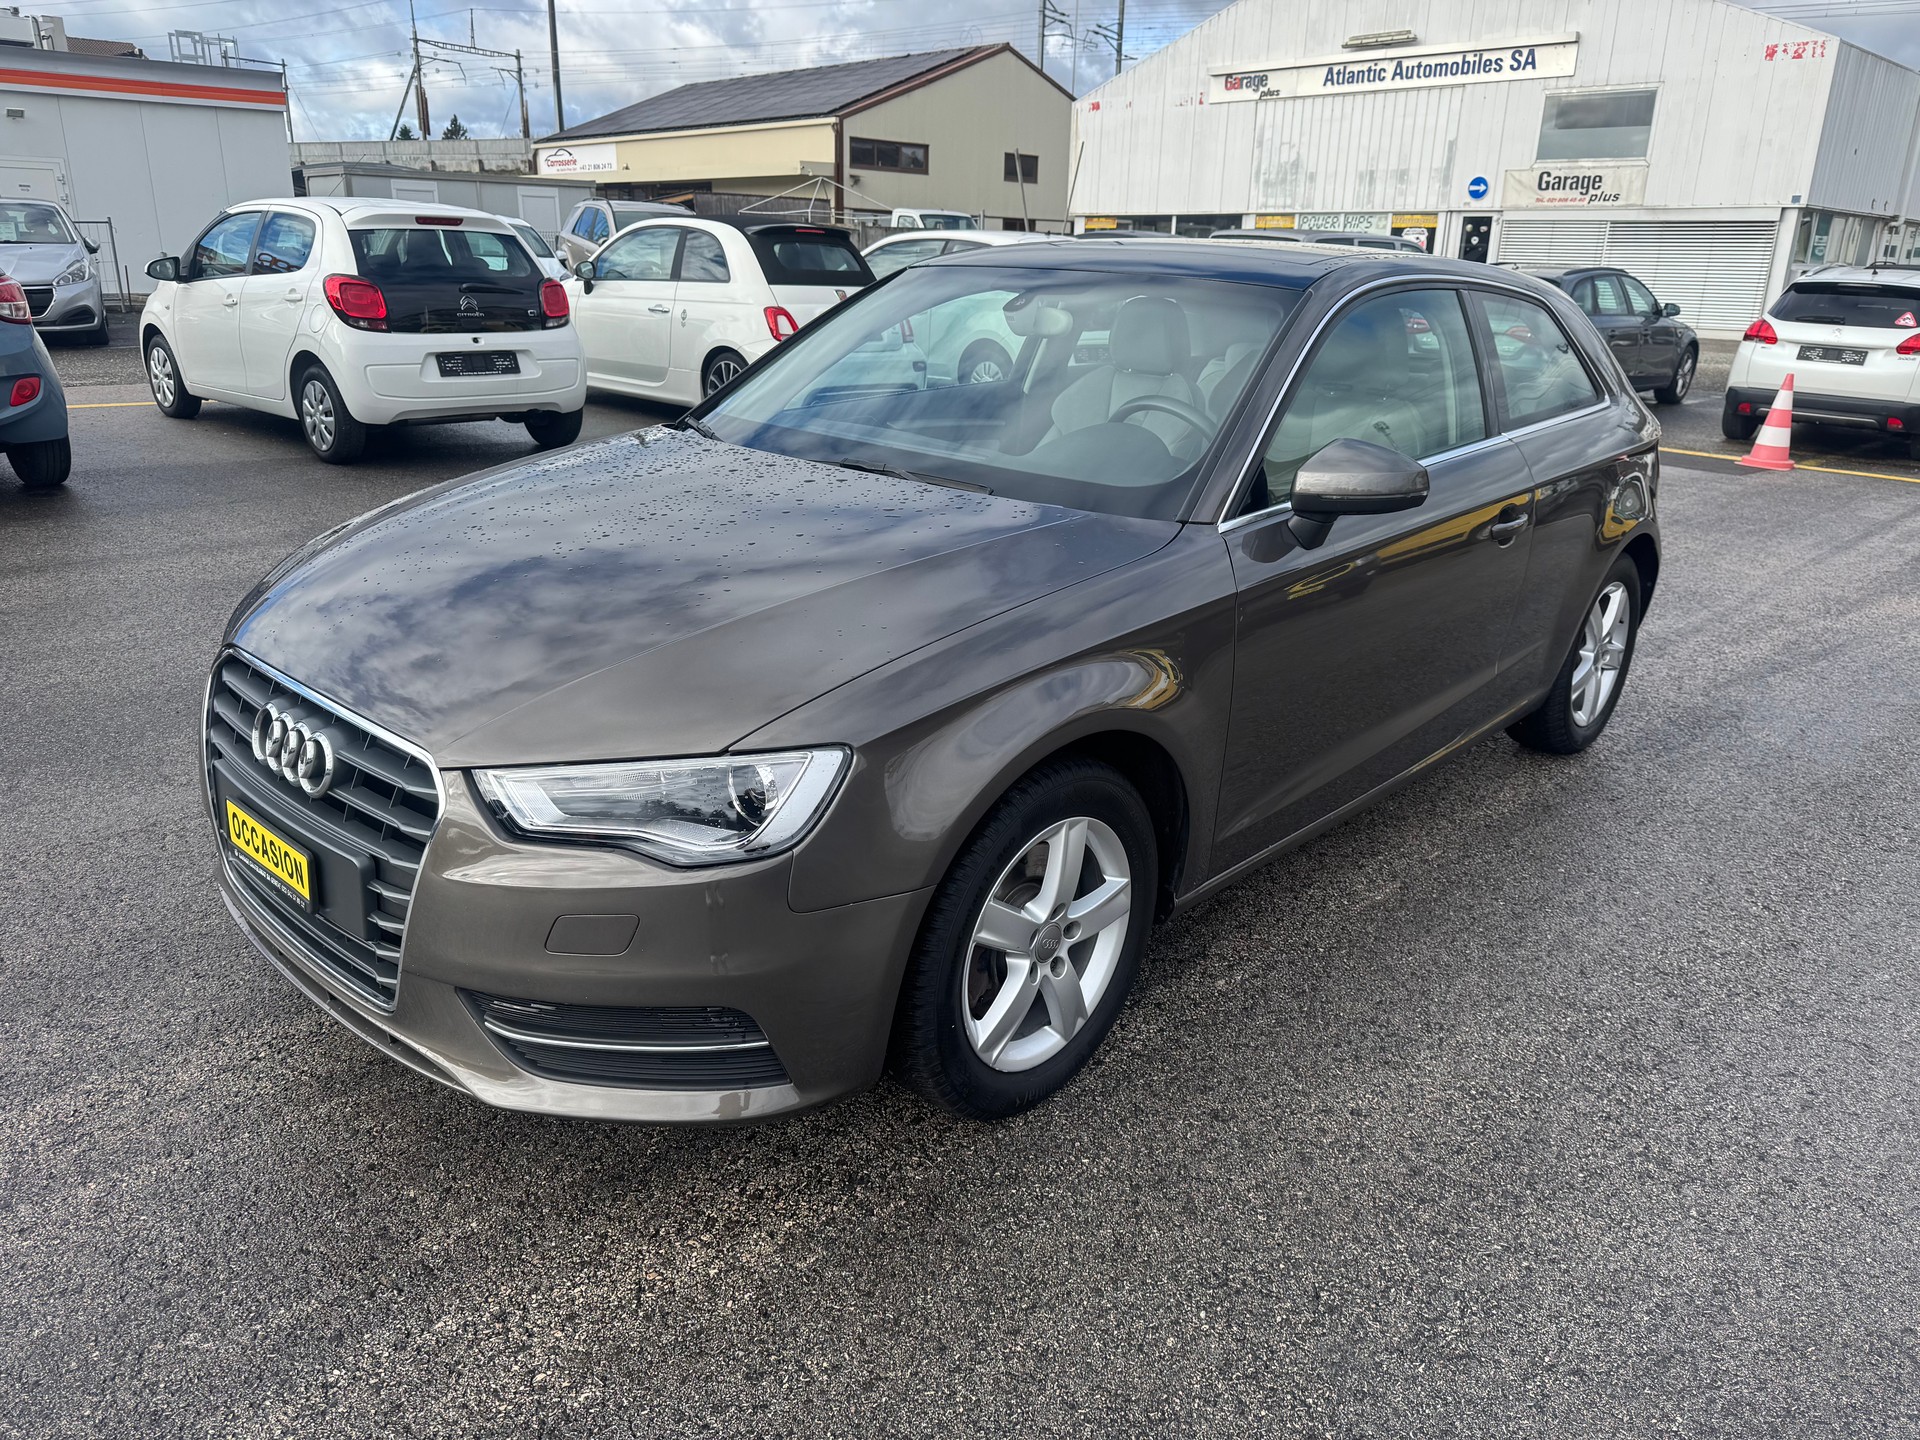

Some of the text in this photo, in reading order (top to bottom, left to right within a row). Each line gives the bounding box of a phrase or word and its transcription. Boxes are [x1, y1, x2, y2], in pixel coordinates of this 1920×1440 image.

[1323, 48, 1537, 86] Atlantic Automobiles SA
[1224, 73, 1269, 93] Garage
[1258, 87, 1281, 100] plus
[547, 158, 577, 167] Carrosserie
[1537, 171, 1603, 196] Garage
[1587, 191, 1621, 204] plus
[1337, 215, 1374, 229] HIPS
[232, 812, 305, 889] OCCASION
